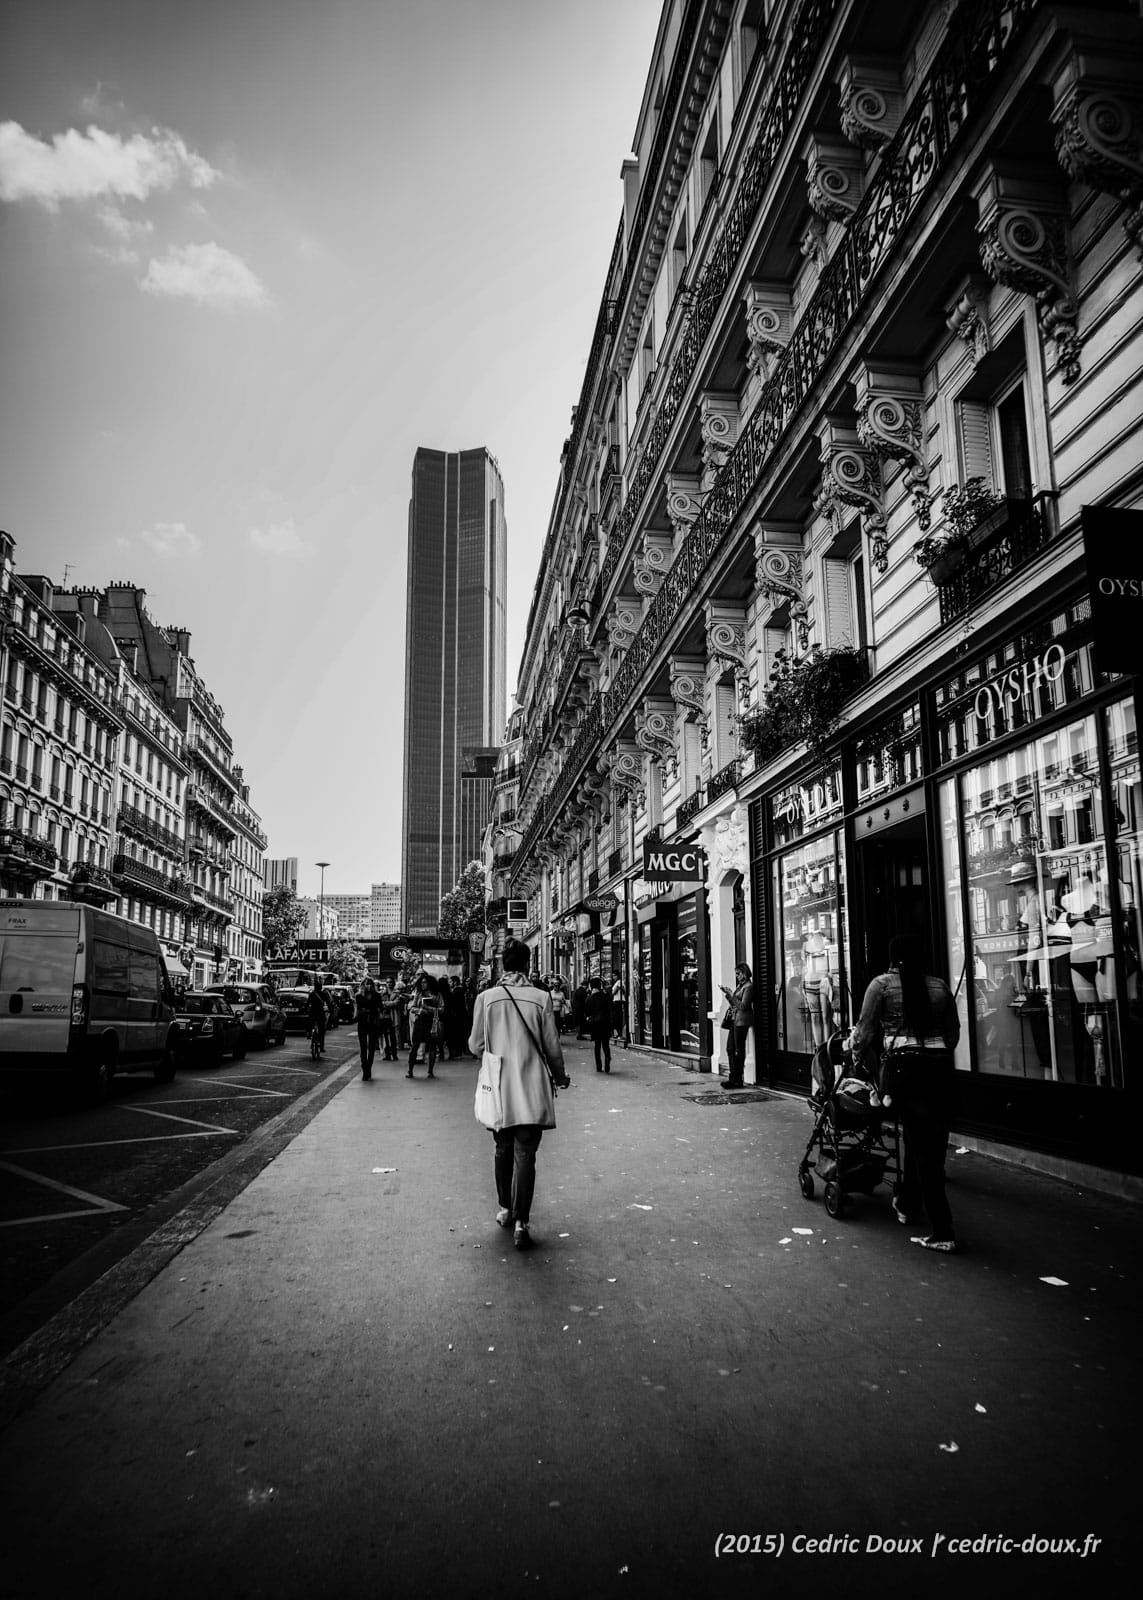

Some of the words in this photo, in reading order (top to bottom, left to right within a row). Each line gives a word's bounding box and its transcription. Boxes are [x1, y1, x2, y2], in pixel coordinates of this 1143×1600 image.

[975, 643, 1066, 720] OYSHO
[647, 851, 696, 872] MGC
[586, 897, 615, 909] valege
